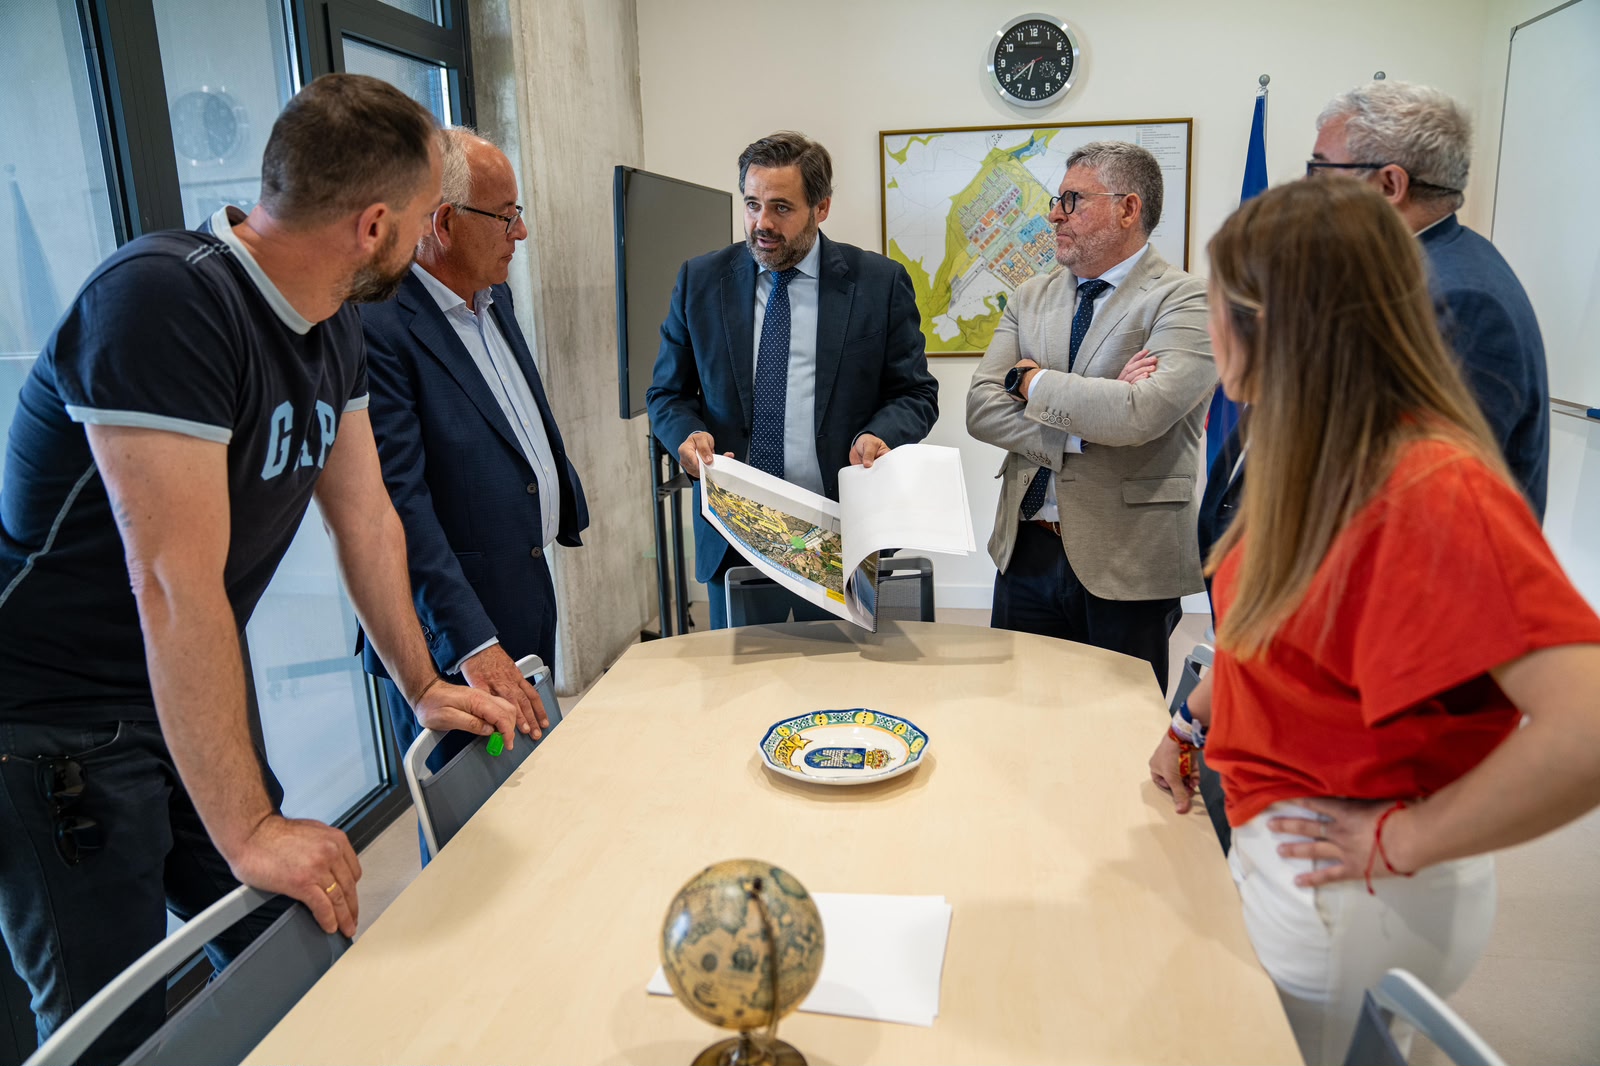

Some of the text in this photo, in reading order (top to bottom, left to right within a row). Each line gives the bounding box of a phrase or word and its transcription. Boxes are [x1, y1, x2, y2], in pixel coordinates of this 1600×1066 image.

[1017, 32, 1024, 41] 11
[1030, 28, 1038, 37] 12
[1046, 31, 1050, 40] 1
[1006, 44, 1014, 52] 10
[1056, 42, 1062, 50] 2
[1000, 59, 1006, 68] 9
[1060, 56, 1066, 66] 3
[1006, 74, 1010, 82] 8
[1056, 72, 1060, 80] 4
[1016, 84, 1022, 92] 7
[1045, 82, 1050, 91] 5
[1030, 88, 1036, 96] 6
